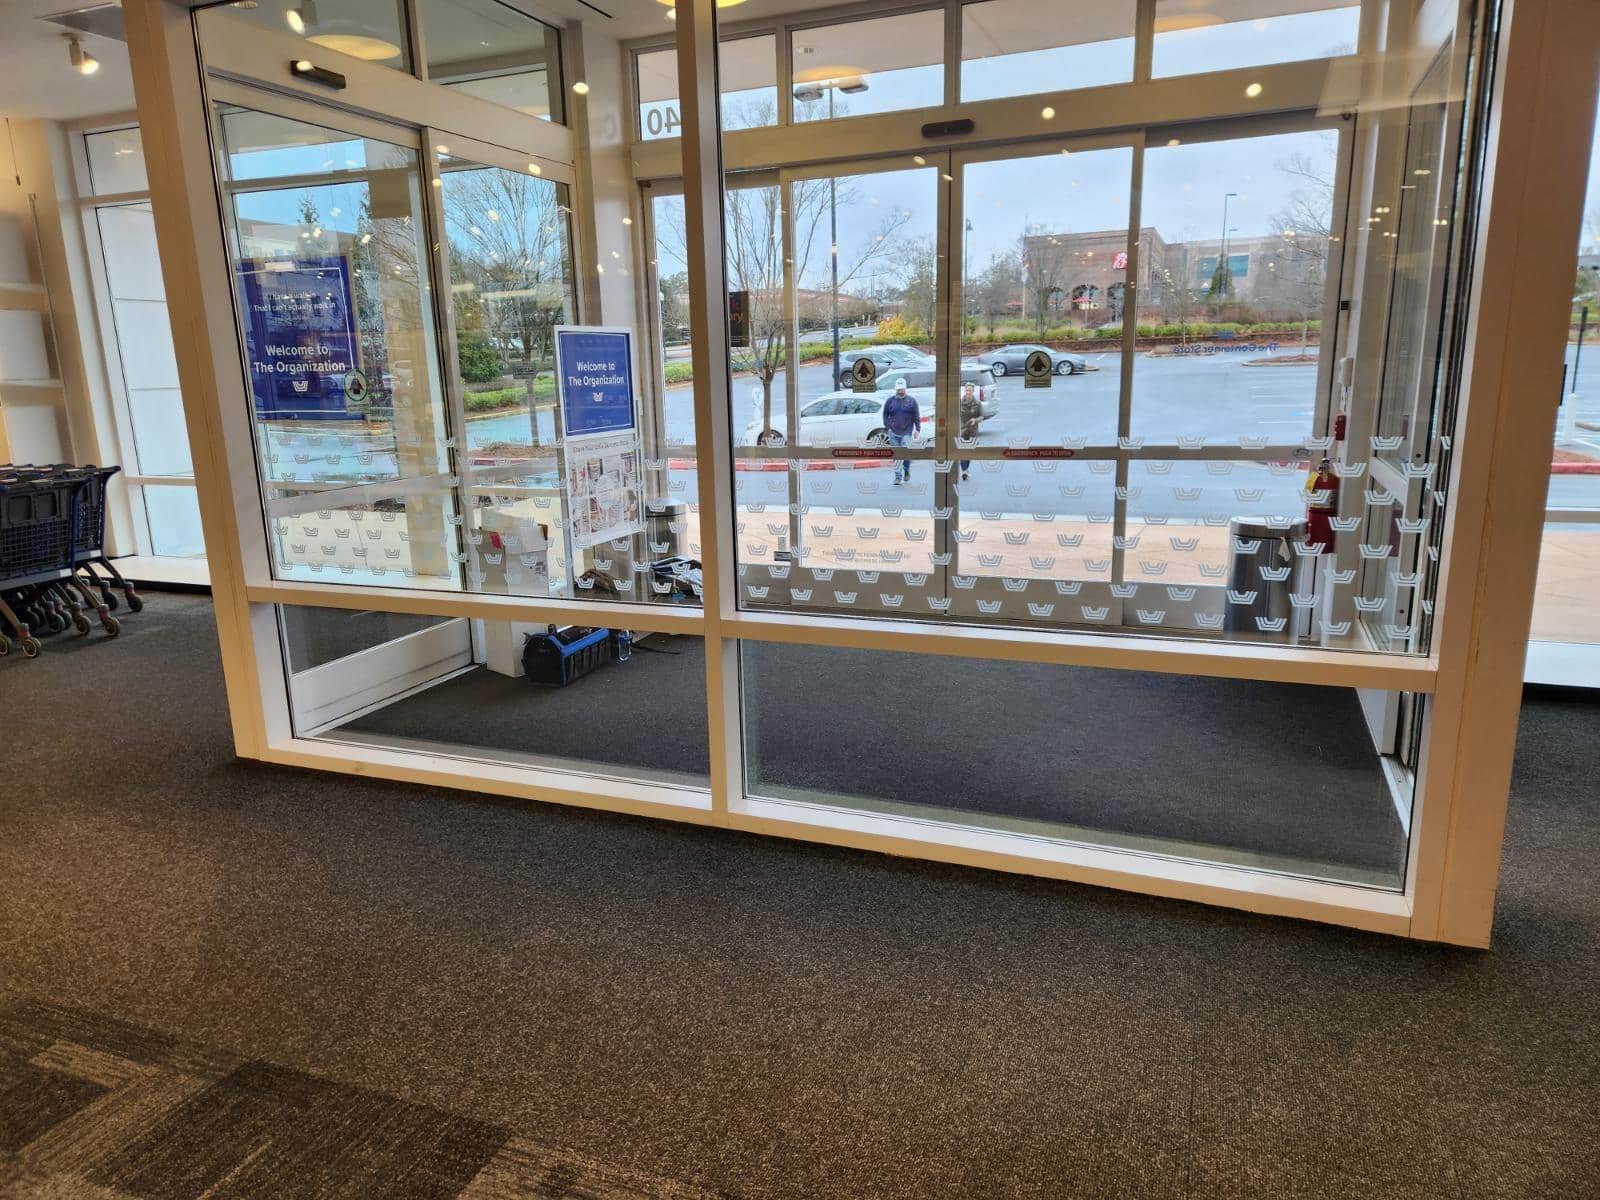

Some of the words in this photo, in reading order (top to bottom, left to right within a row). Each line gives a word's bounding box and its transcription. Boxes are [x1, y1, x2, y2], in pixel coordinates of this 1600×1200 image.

[265, 344, 315, 357] Welcome
[317, 344, 329, 355] to
[254, 361, 273, 373] The
[276, 360, 346, 375] Organization
[576, 361, 607, 372] Welcome
[608, 361, 616, 371] to
[568, 376, 582, 387] The
[583, 374, 625, 387] Organization
